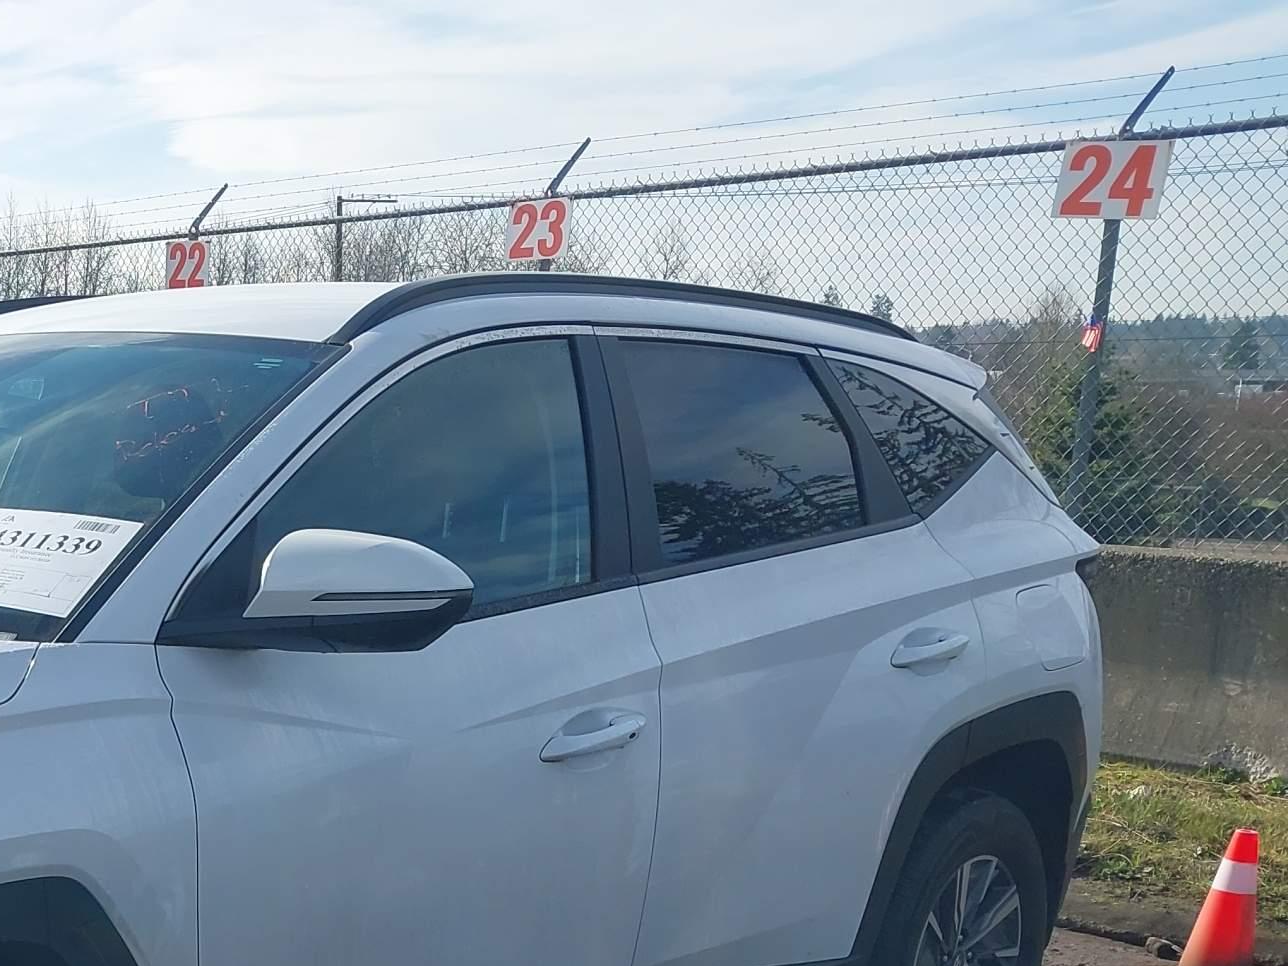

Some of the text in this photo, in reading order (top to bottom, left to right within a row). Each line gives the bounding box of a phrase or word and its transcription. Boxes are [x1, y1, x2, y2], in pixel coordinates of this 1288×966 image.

[1059, 144, 1157, 217] 24
[509, 200, 566, 259] 23
[168, 242, 206, 289] 22
